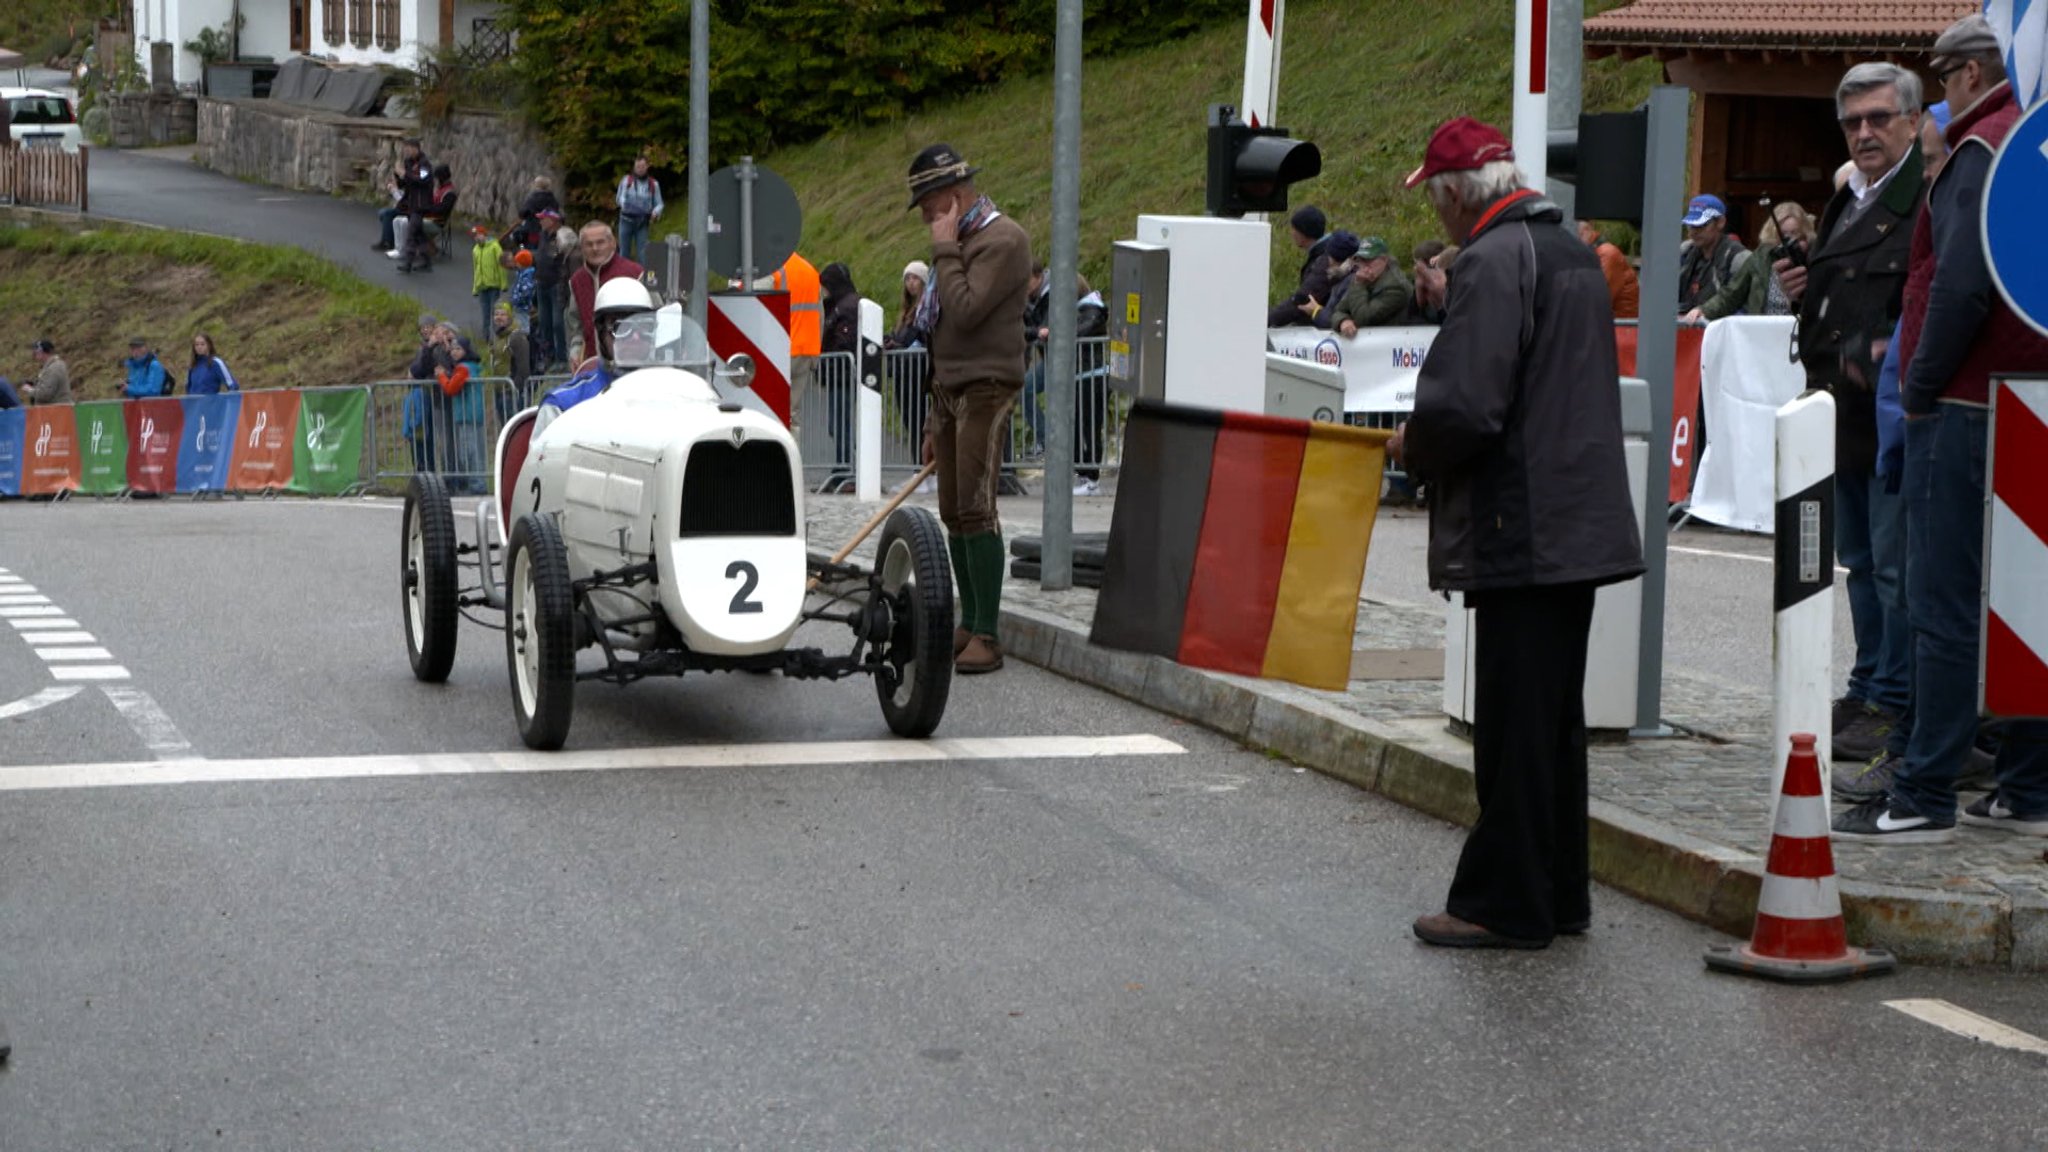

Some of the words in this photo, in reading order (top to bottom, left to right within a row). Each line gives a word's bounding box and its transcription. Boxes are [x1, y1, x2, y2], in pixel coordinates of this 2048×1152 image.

[1318, 347, 1338, 366] Esso
[1392, 347, 1425, 368] Mobil
[725, 560, 763, 614] 2
